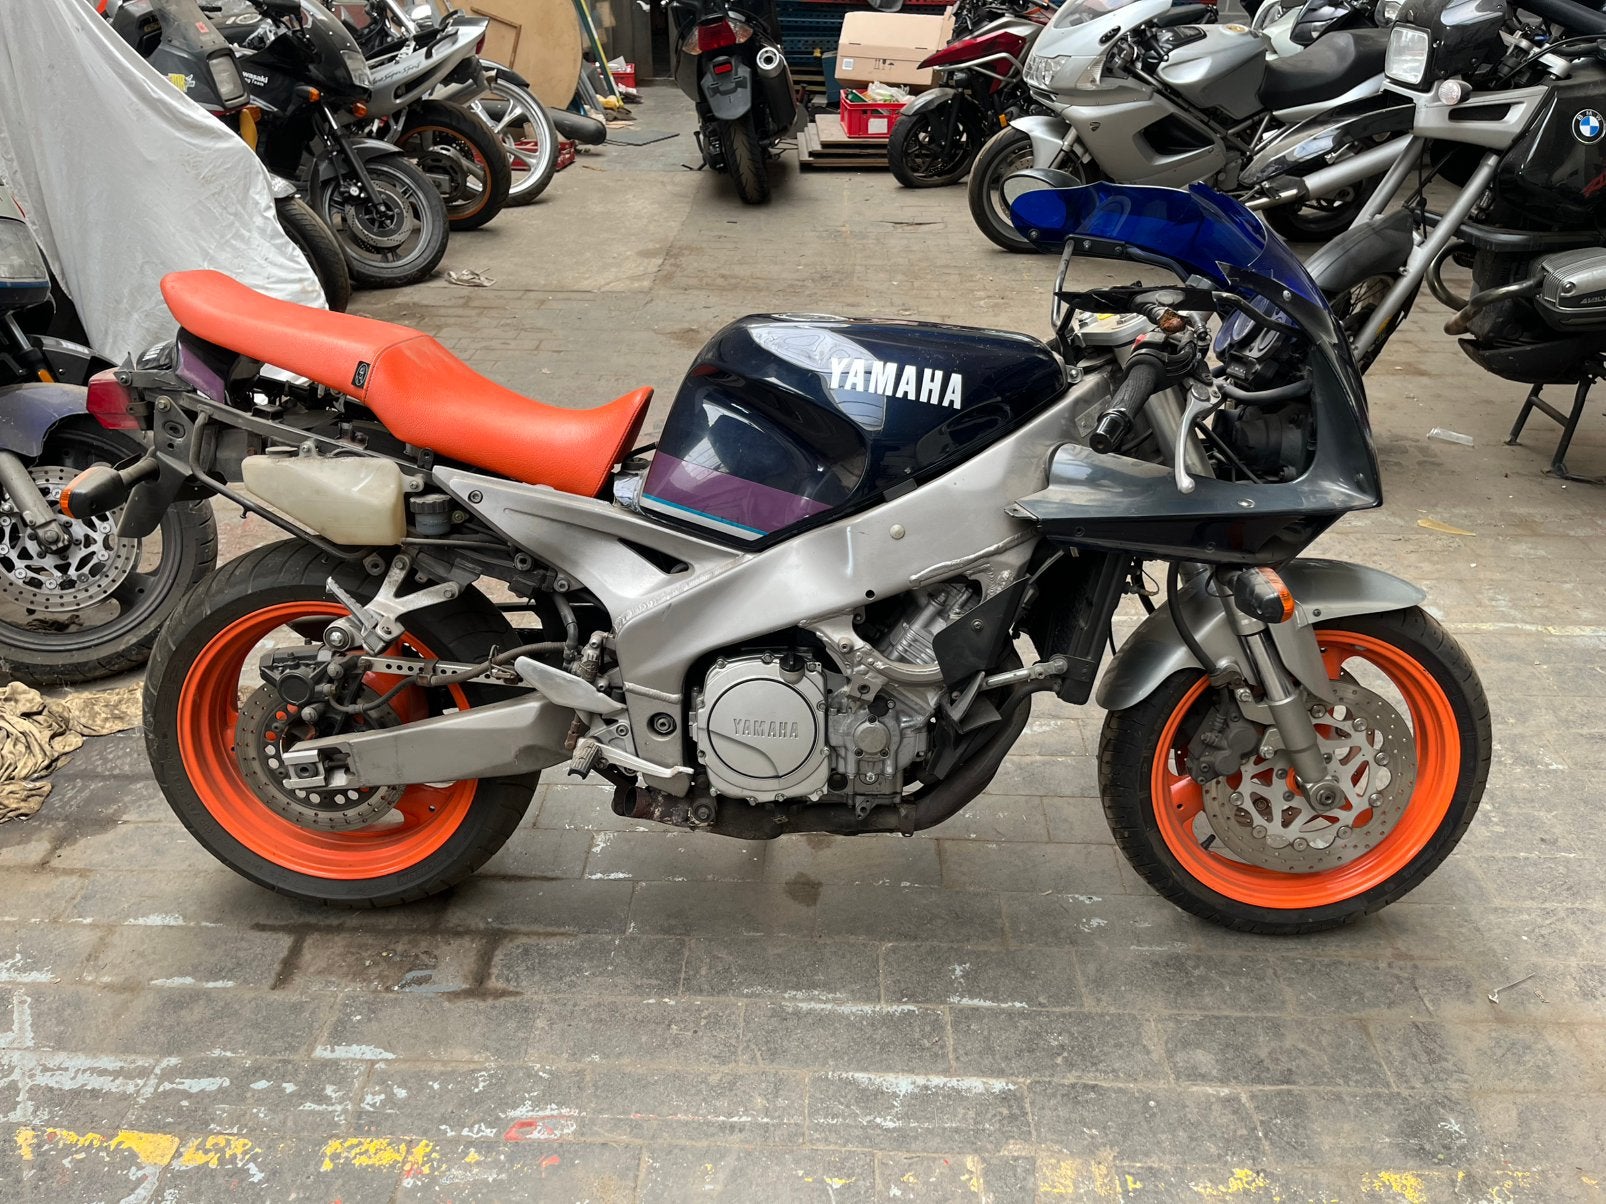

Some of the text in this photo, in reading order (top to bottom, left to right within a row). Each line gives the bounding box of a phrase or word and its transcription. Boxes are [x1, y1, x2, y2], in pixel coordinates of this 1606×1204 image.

[242, 71, 269, 84] wasaki
[829, 357, 963, 410] YAMAHA
[733, 718, 799, 740] YAMAHA
